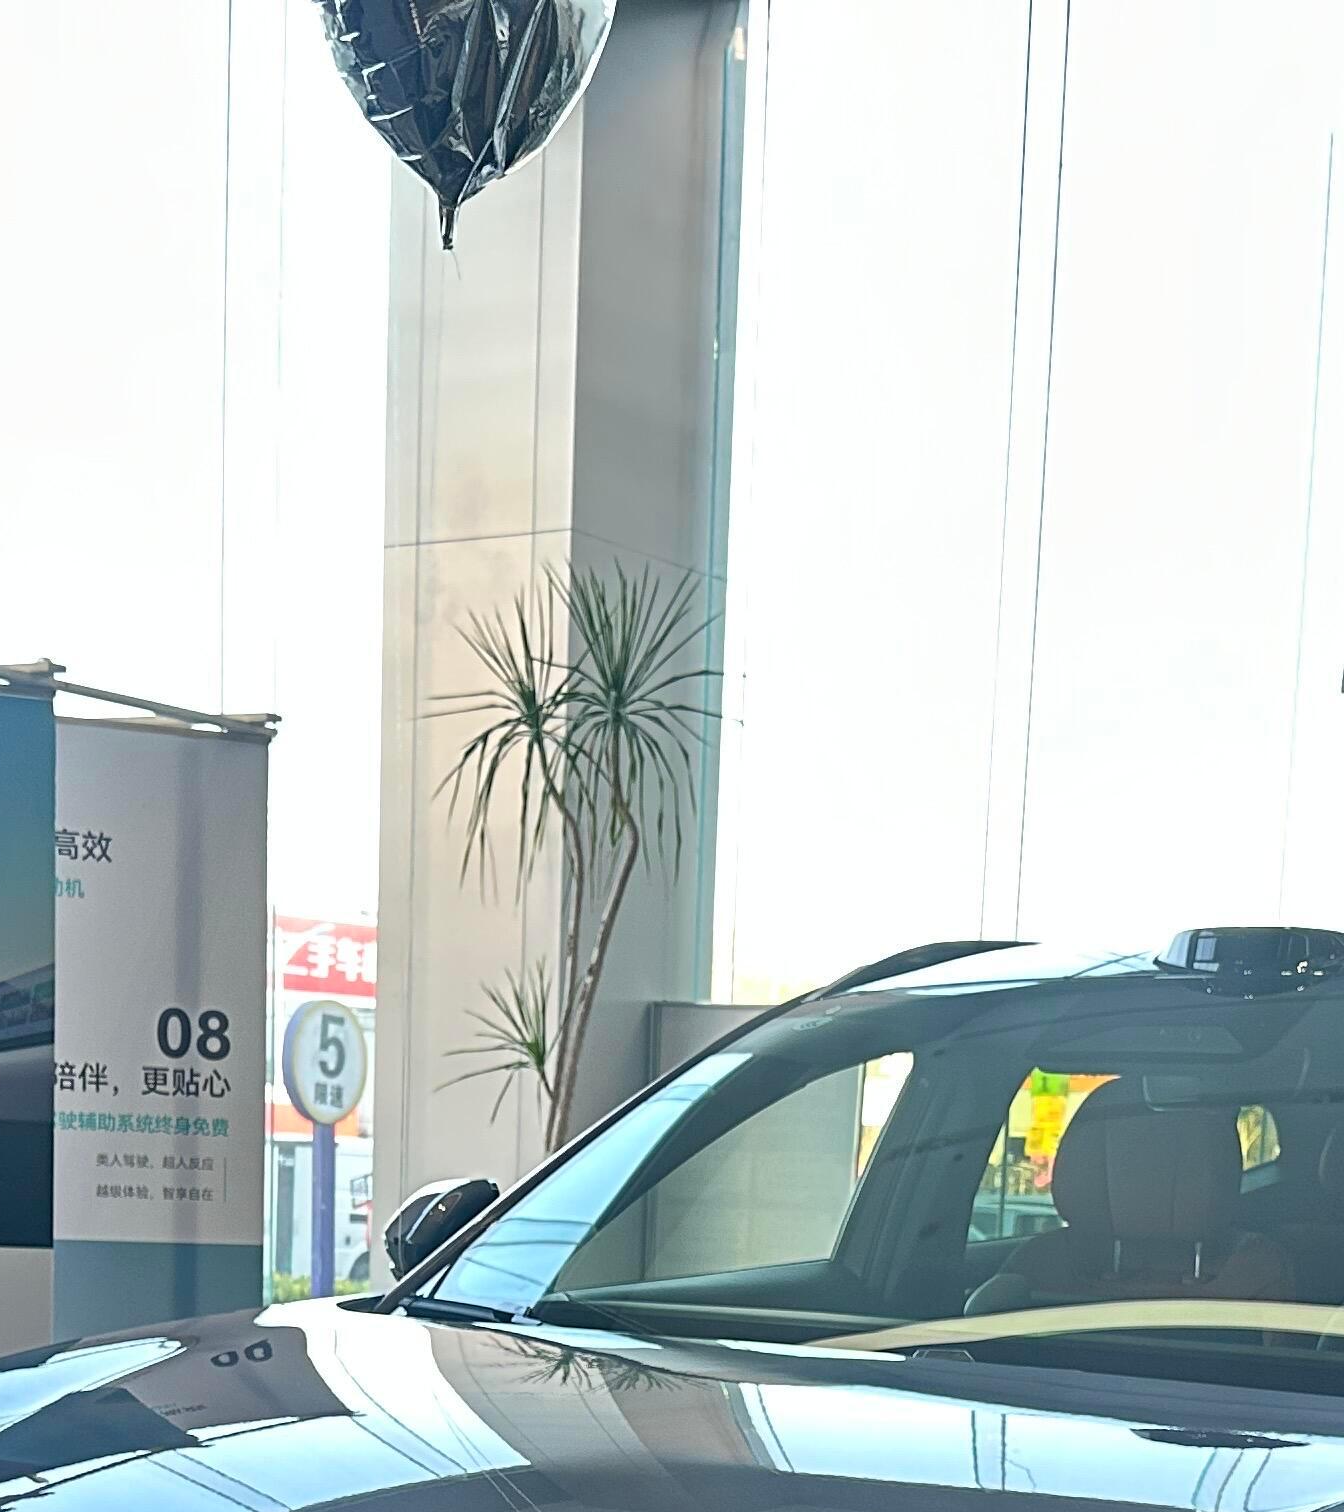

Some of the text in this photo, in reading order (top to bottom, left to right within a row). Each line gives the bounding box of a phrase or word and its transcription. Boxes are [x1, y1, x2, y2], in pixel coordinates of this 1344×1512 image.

[55, 828, 113, 864] 高效
[157, 1007, 232, 1061] 08
[318, 1014, 345, 1079] 5
[54, 1111, 230, 1138] 驶辅助系统终身免费
